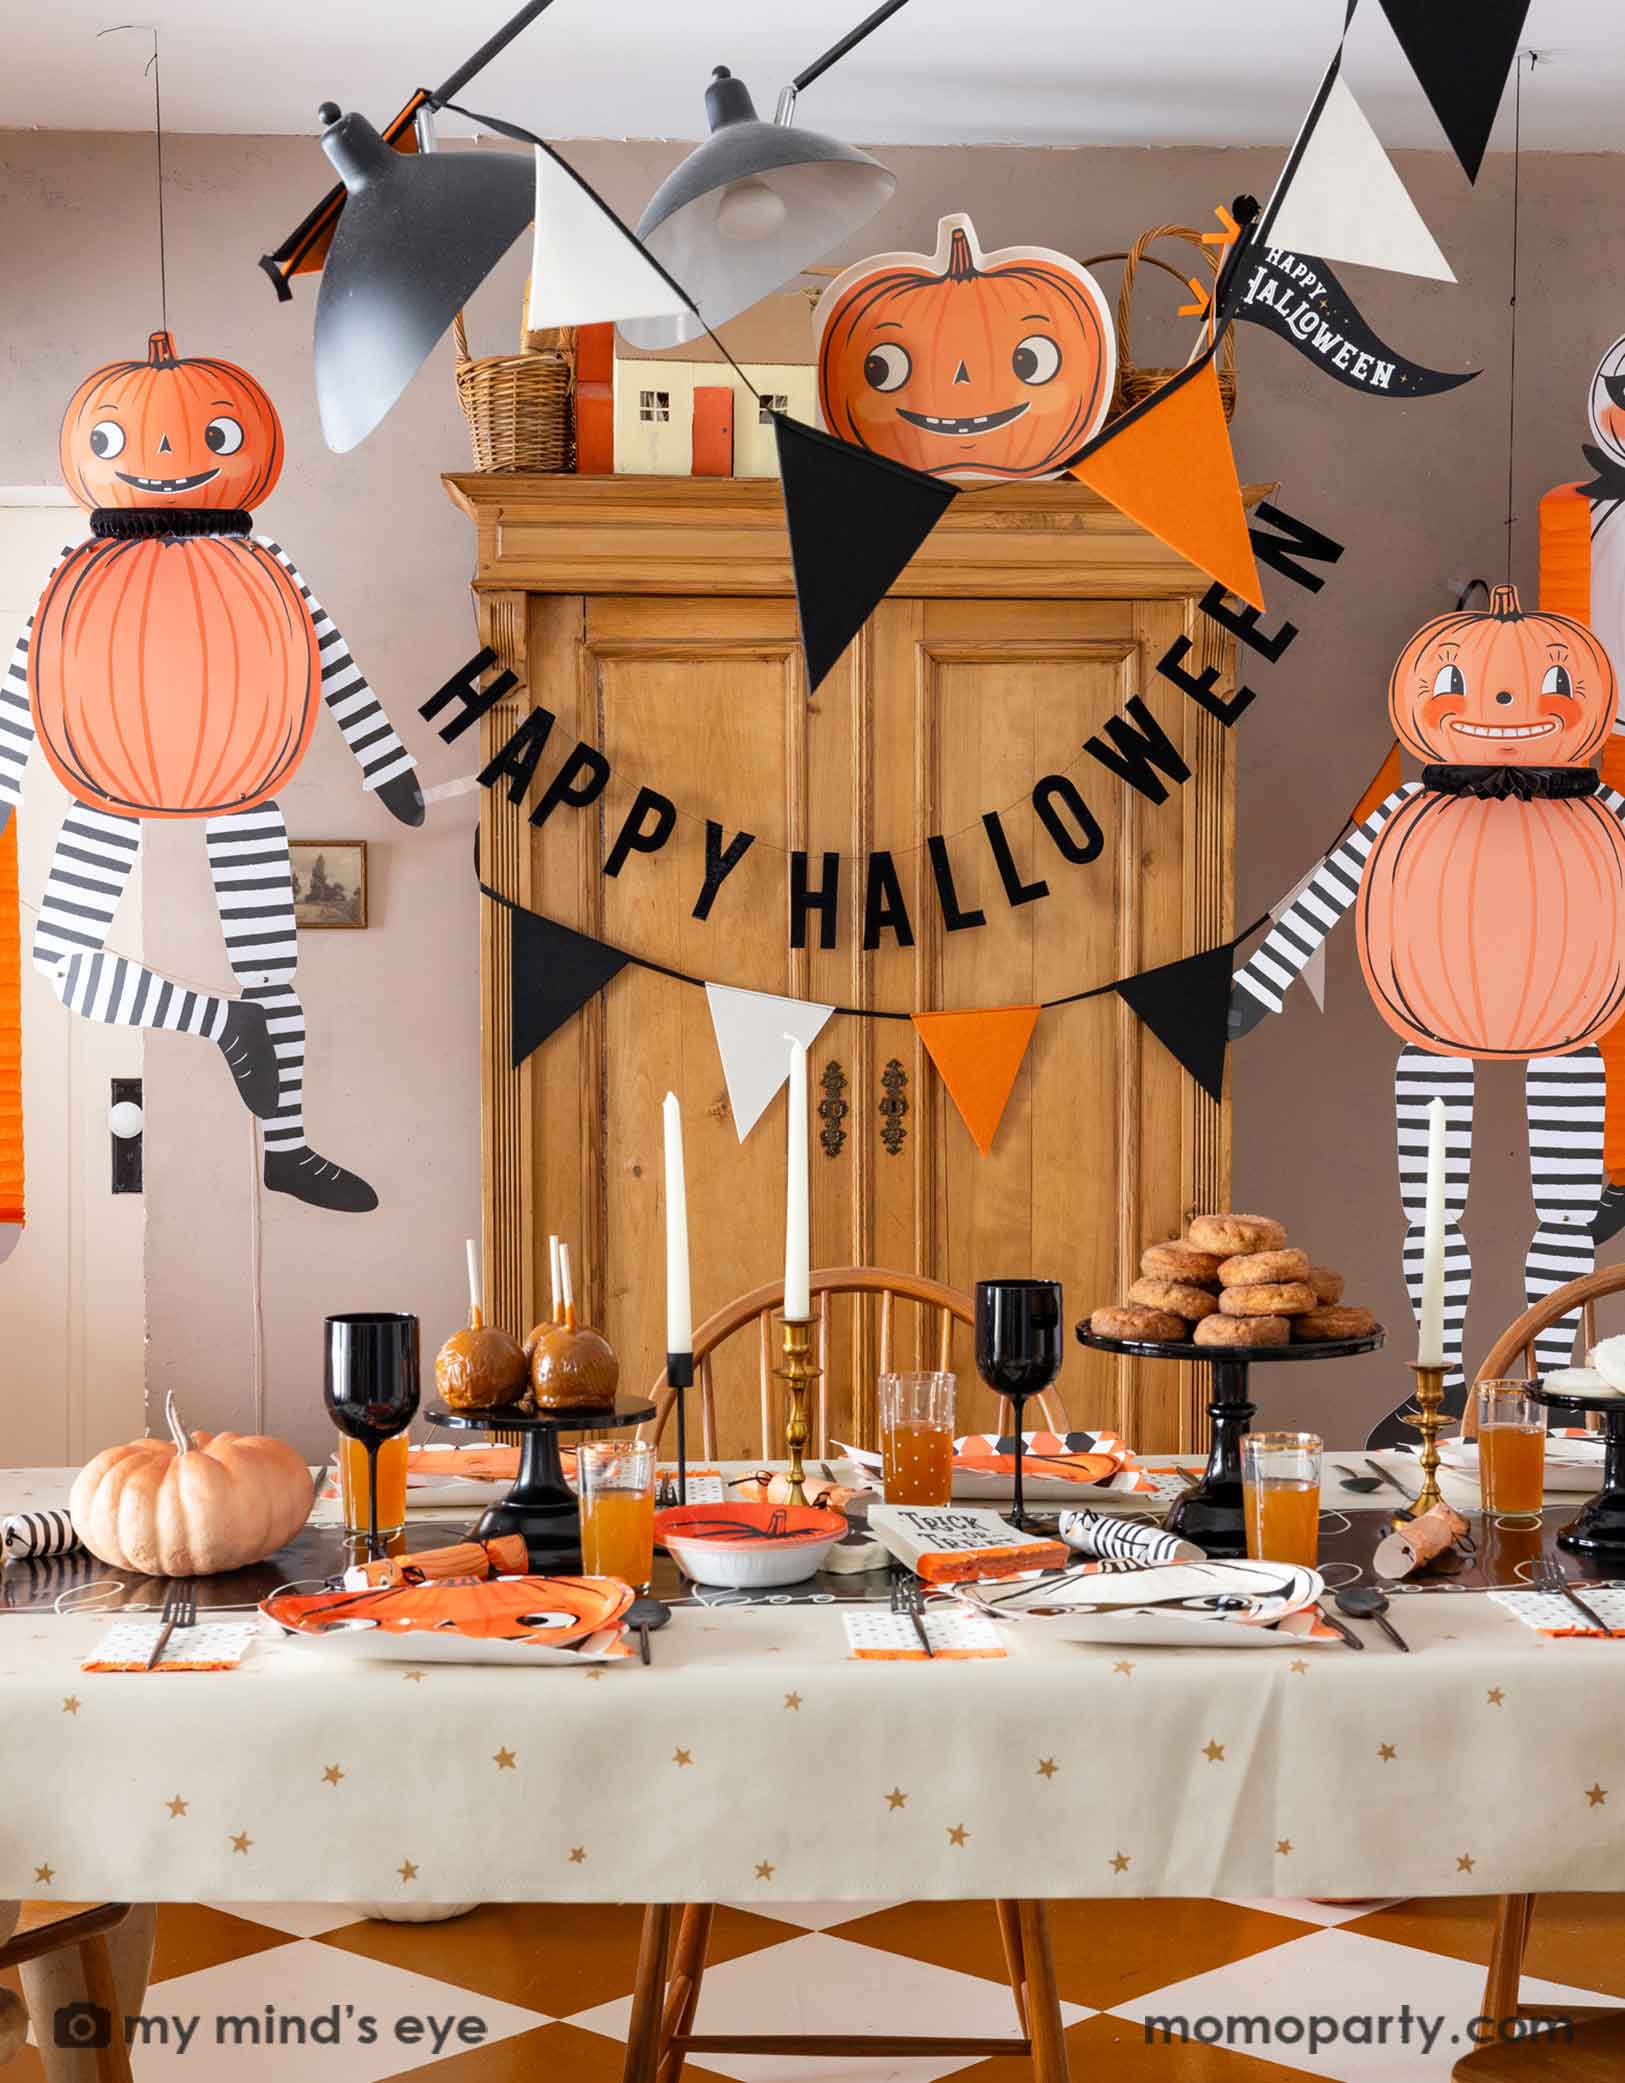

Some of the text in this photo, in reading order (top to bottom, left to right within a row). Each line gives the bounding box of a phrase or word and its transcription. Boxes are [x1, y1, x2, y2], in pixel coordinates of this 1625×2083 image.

[1265, 246, 1328, 300] HAPPY
[418, 502, 1346, 951] HAPPY HALLOWEEN
[897, 1511, 991, 1532] TRICK
